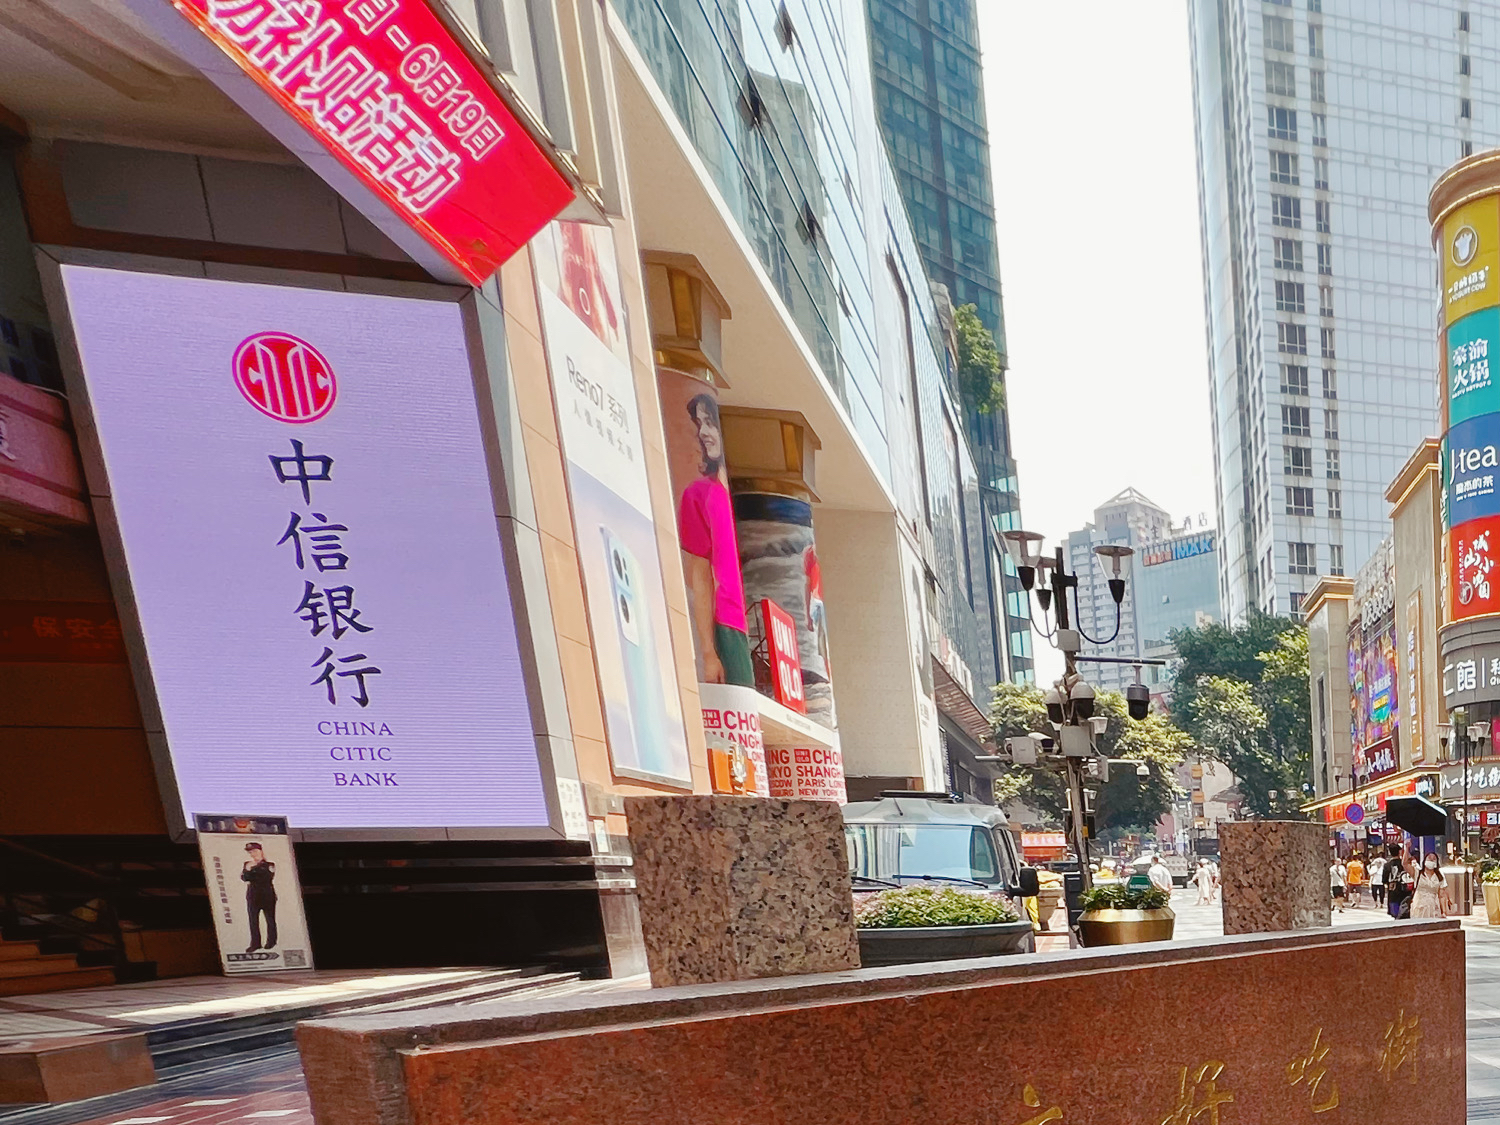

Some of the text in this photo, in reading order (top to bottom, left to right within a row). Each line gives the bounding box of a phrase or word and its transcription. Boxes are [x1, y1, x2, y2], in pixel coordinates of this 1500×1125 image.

[1452, 359, 1490, 392] 火锅
[267, 438, 382, 708] 中信银行
[772, 615, 797, 662] UNI
[778, 658, 803, 703] QLO
[316, 721, 395, 737] CHINA
[329, 747, 393, 762] CITIC
[332, 772, 400, 788] BANK
